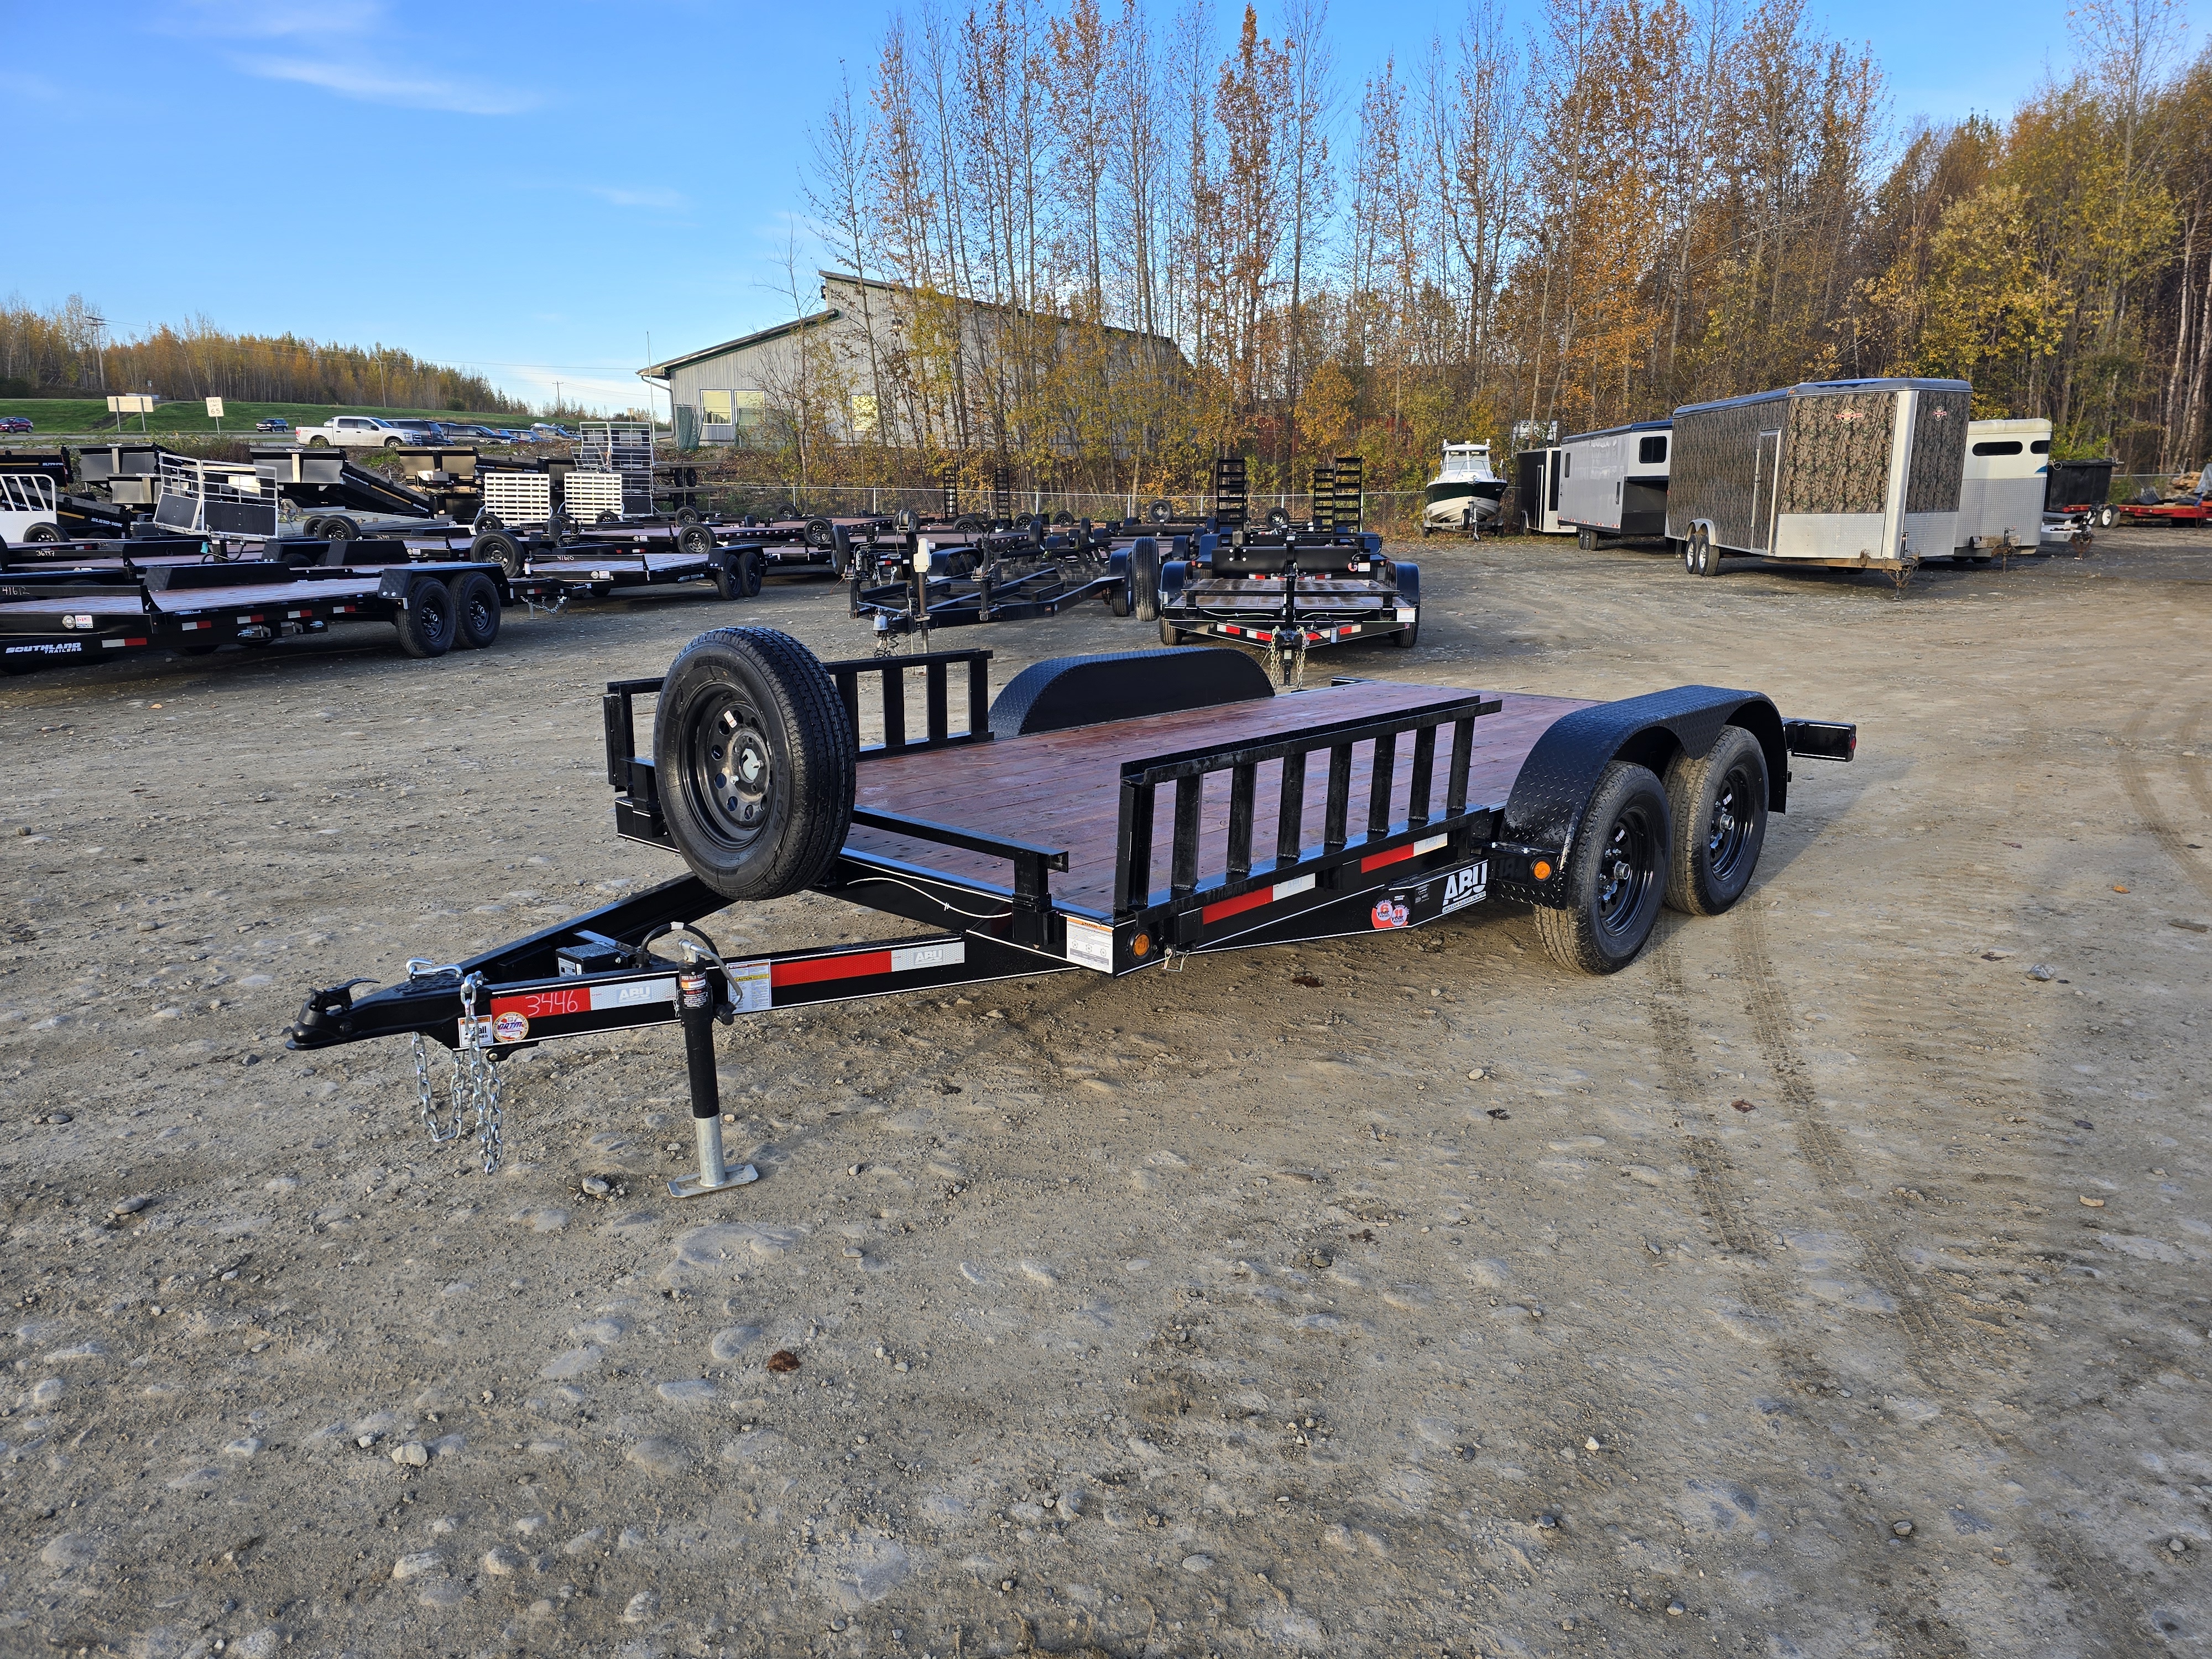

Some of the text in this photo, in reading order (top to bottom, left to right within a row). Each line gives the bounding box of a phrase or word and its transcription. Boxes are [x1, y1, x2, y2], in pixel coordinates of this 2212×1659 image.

[2, 586, 30, 596] 41612
[6, 642, 81, 653] SOUTHLAND
[1443, 863, 1488, 906] ABU
[1380, 904, 1389, 913] 6
[1395, 909, 1403, 917] 11
[915, 950, 942, 962] ABU
[618, 986, 651, 1001] ABU
[525, 990, 578, 1017] 3446
